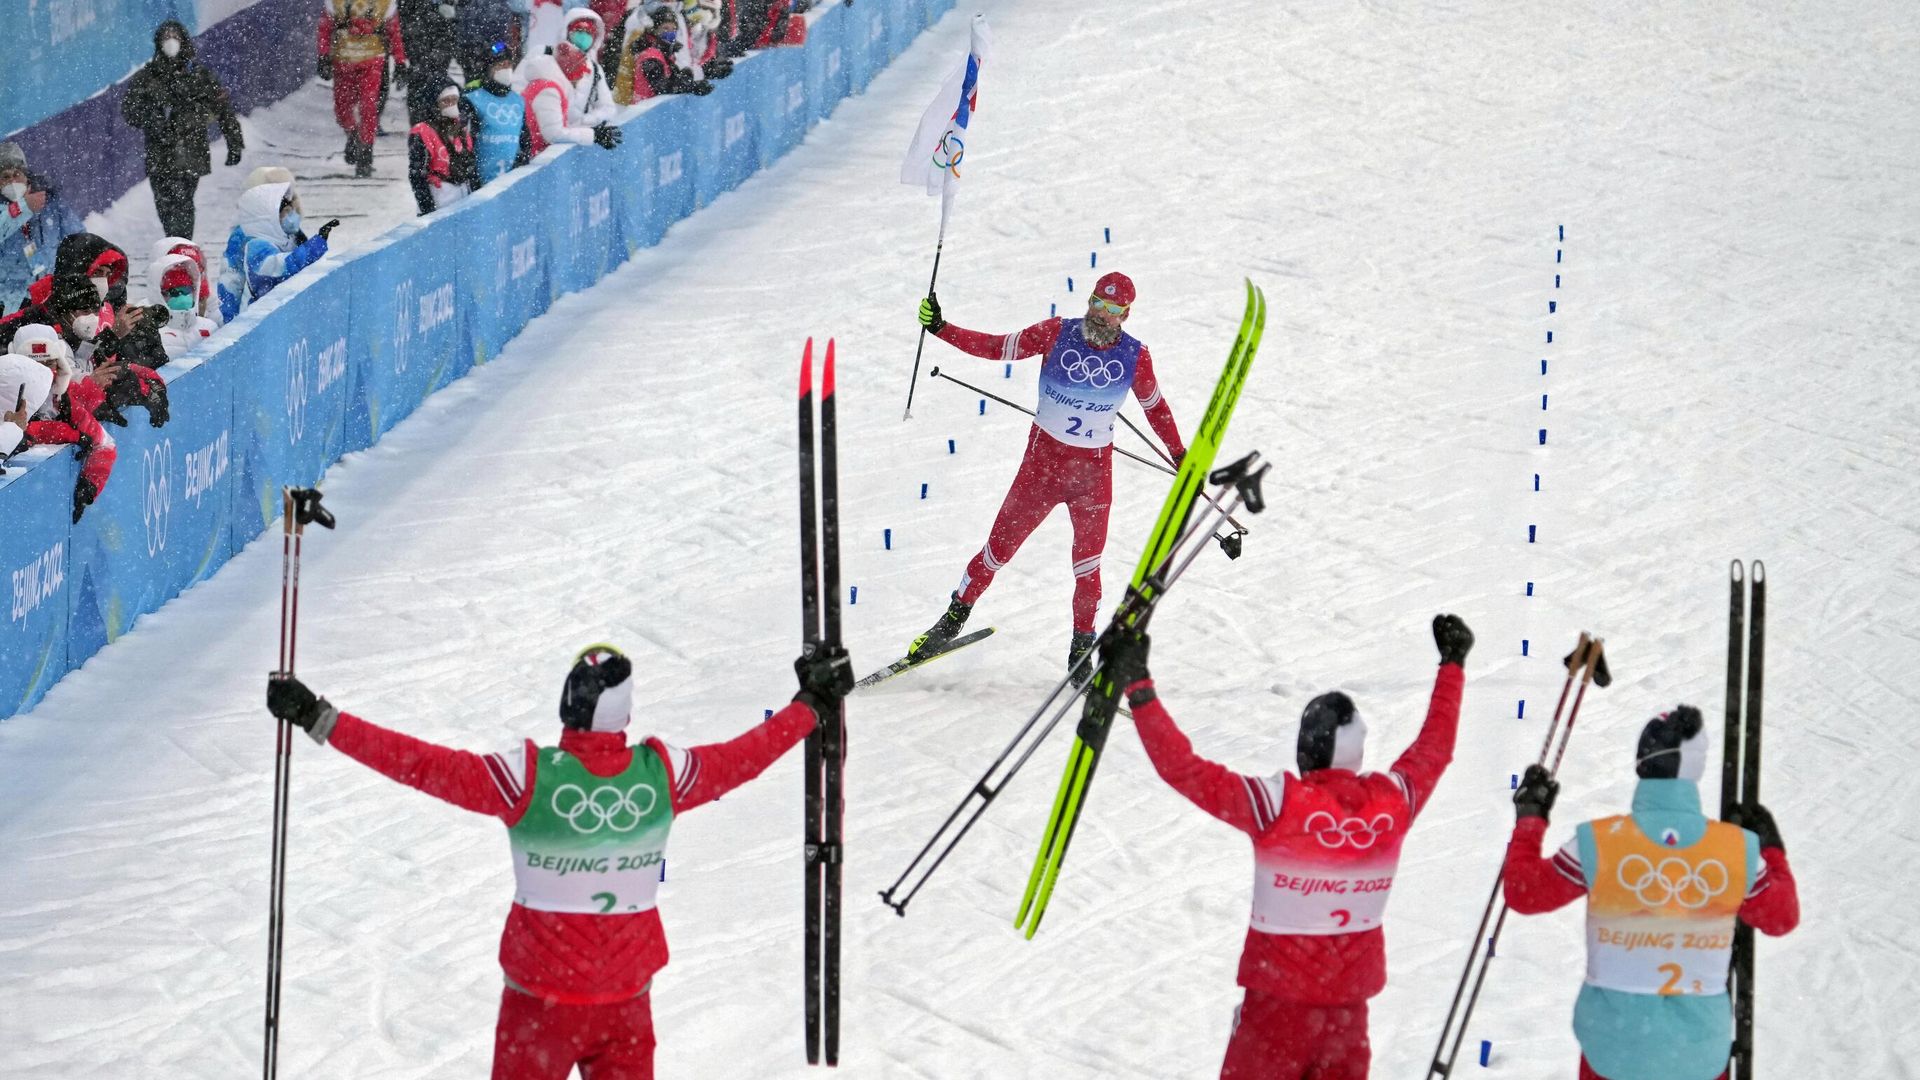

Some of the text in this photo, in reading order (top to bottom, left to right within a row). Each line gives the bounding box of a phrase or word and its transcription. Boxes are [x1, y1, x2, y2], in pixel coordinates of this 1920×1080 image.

[1044, 384, 1085, 410] BEIJING
[1065, 416, 1094, 439] 2 4
[185, 441, 214, 510] BEIJING
[12, 541, 64, 632] BEIJING 2022
[526, 850, 664, 876] BEIJING 2022
[1274, 873, 1393, 896] BEIJING 2022
[1597, 927, 1675, 951] BEIJING
[1657, 962, 1684, 996] 2
